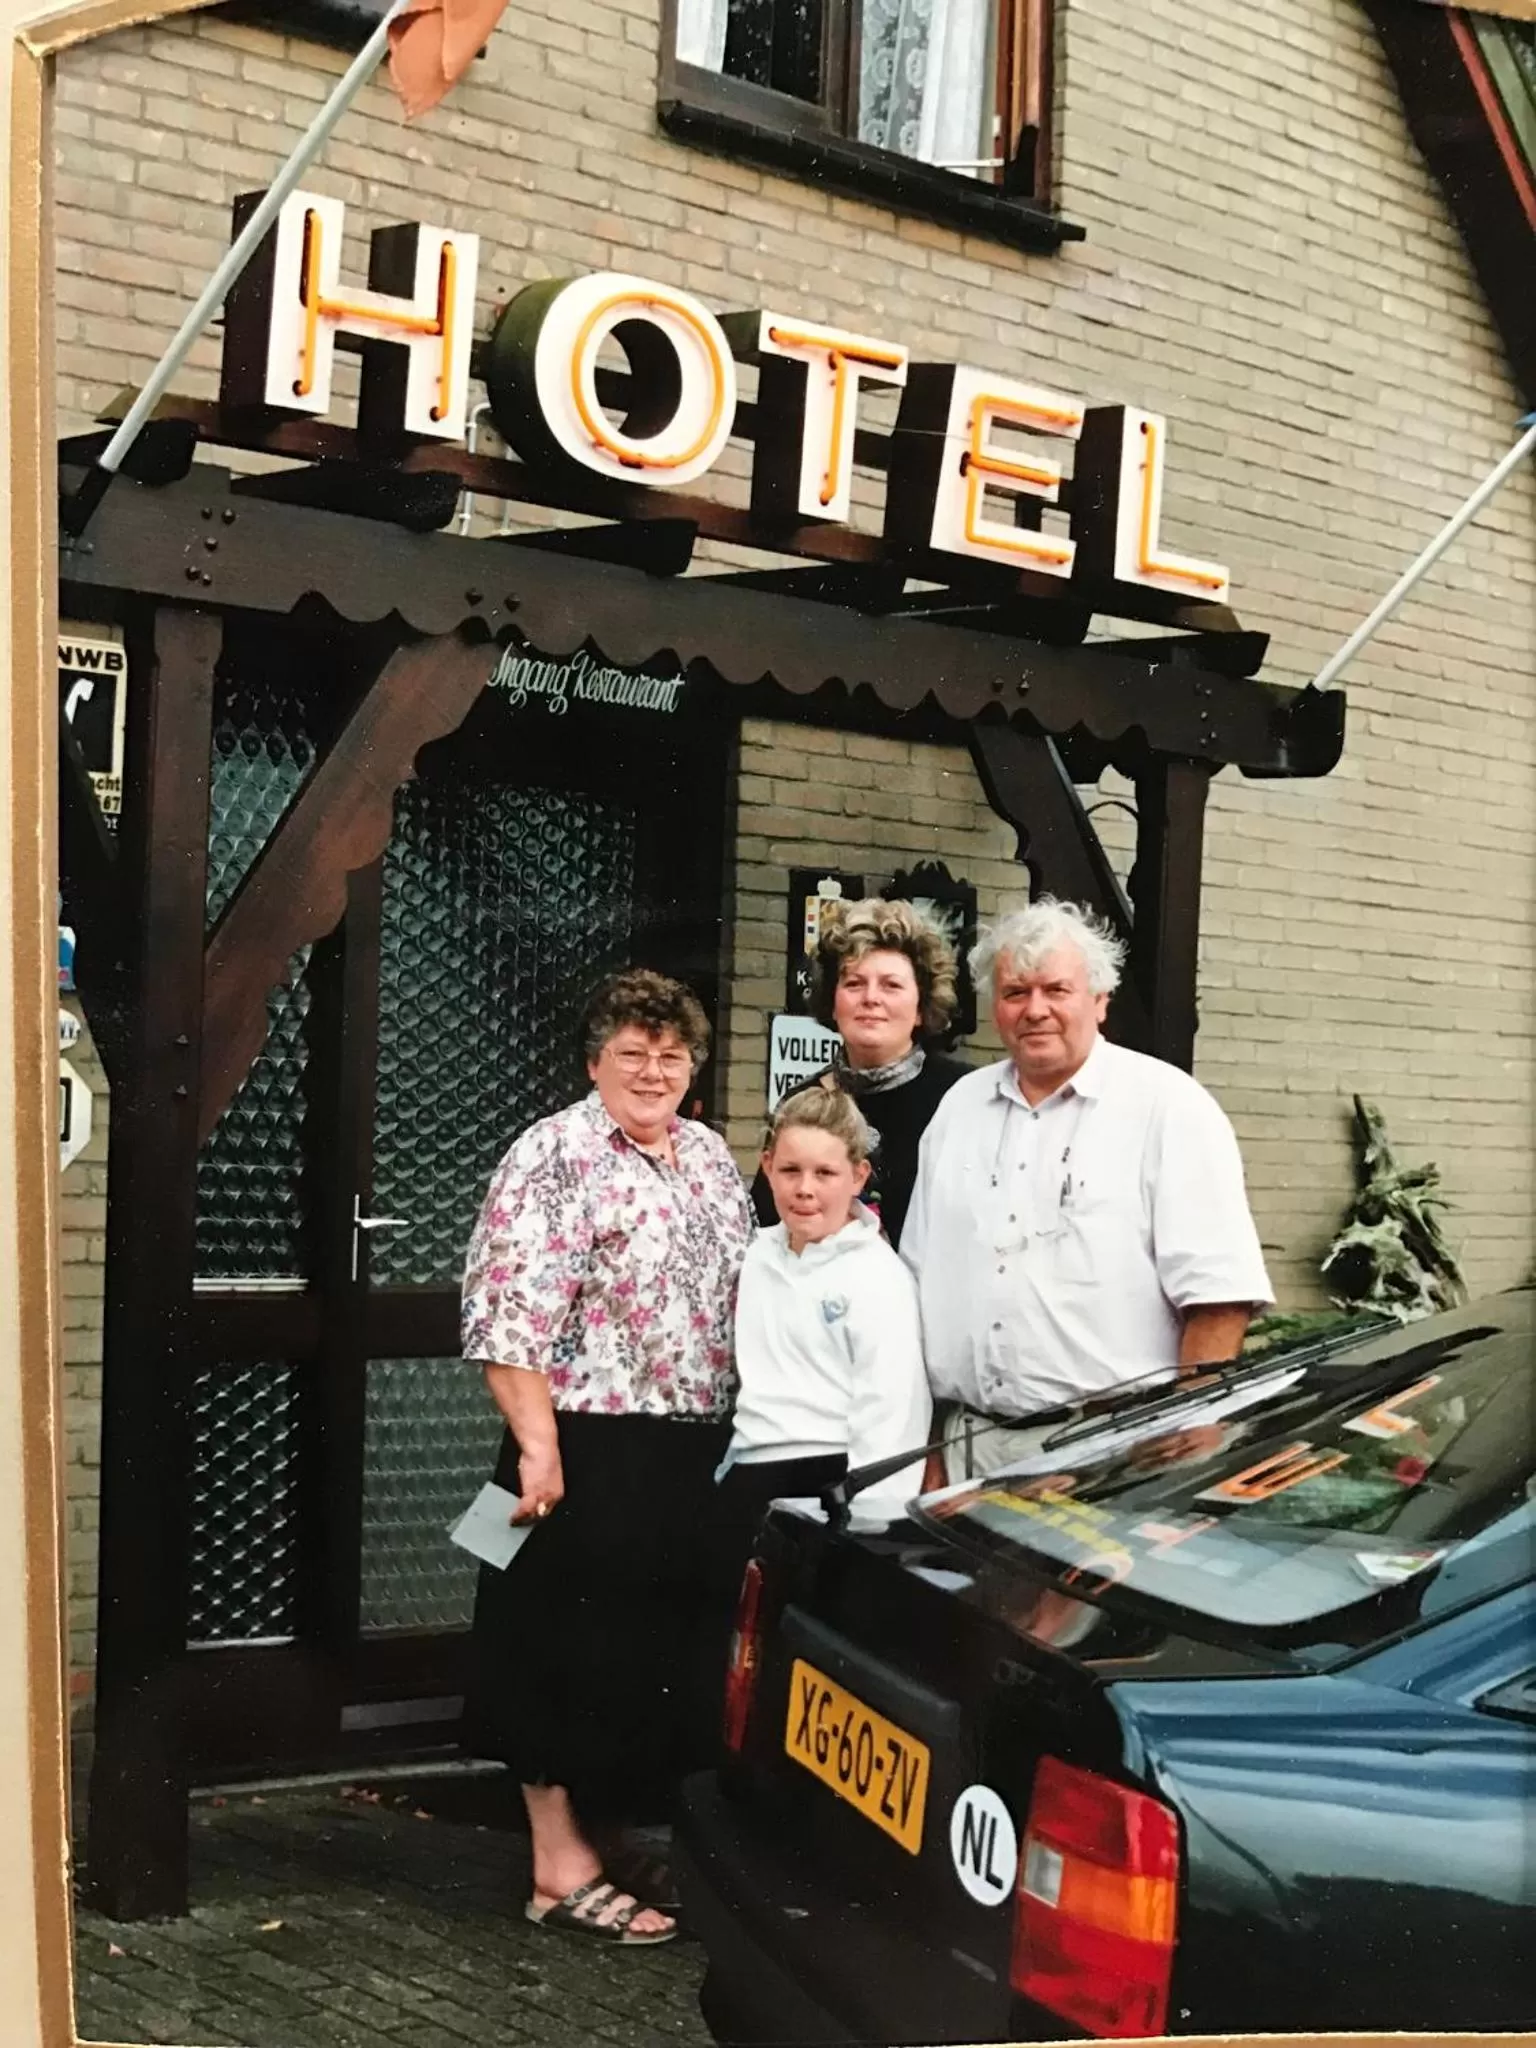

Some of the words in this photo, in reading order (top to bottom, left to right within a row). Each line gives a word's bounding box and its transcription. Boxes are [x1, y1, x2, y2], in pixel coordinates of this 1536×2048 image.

[265, 190, 1230, 604] HOTEL
[487, 643, 570, 714] Ingang
[571, 650, 685, 713] Restaurant
[795, 1677, 920, 1830] XG-60-ZV
[961, 1802, 1003, 1890] NL
